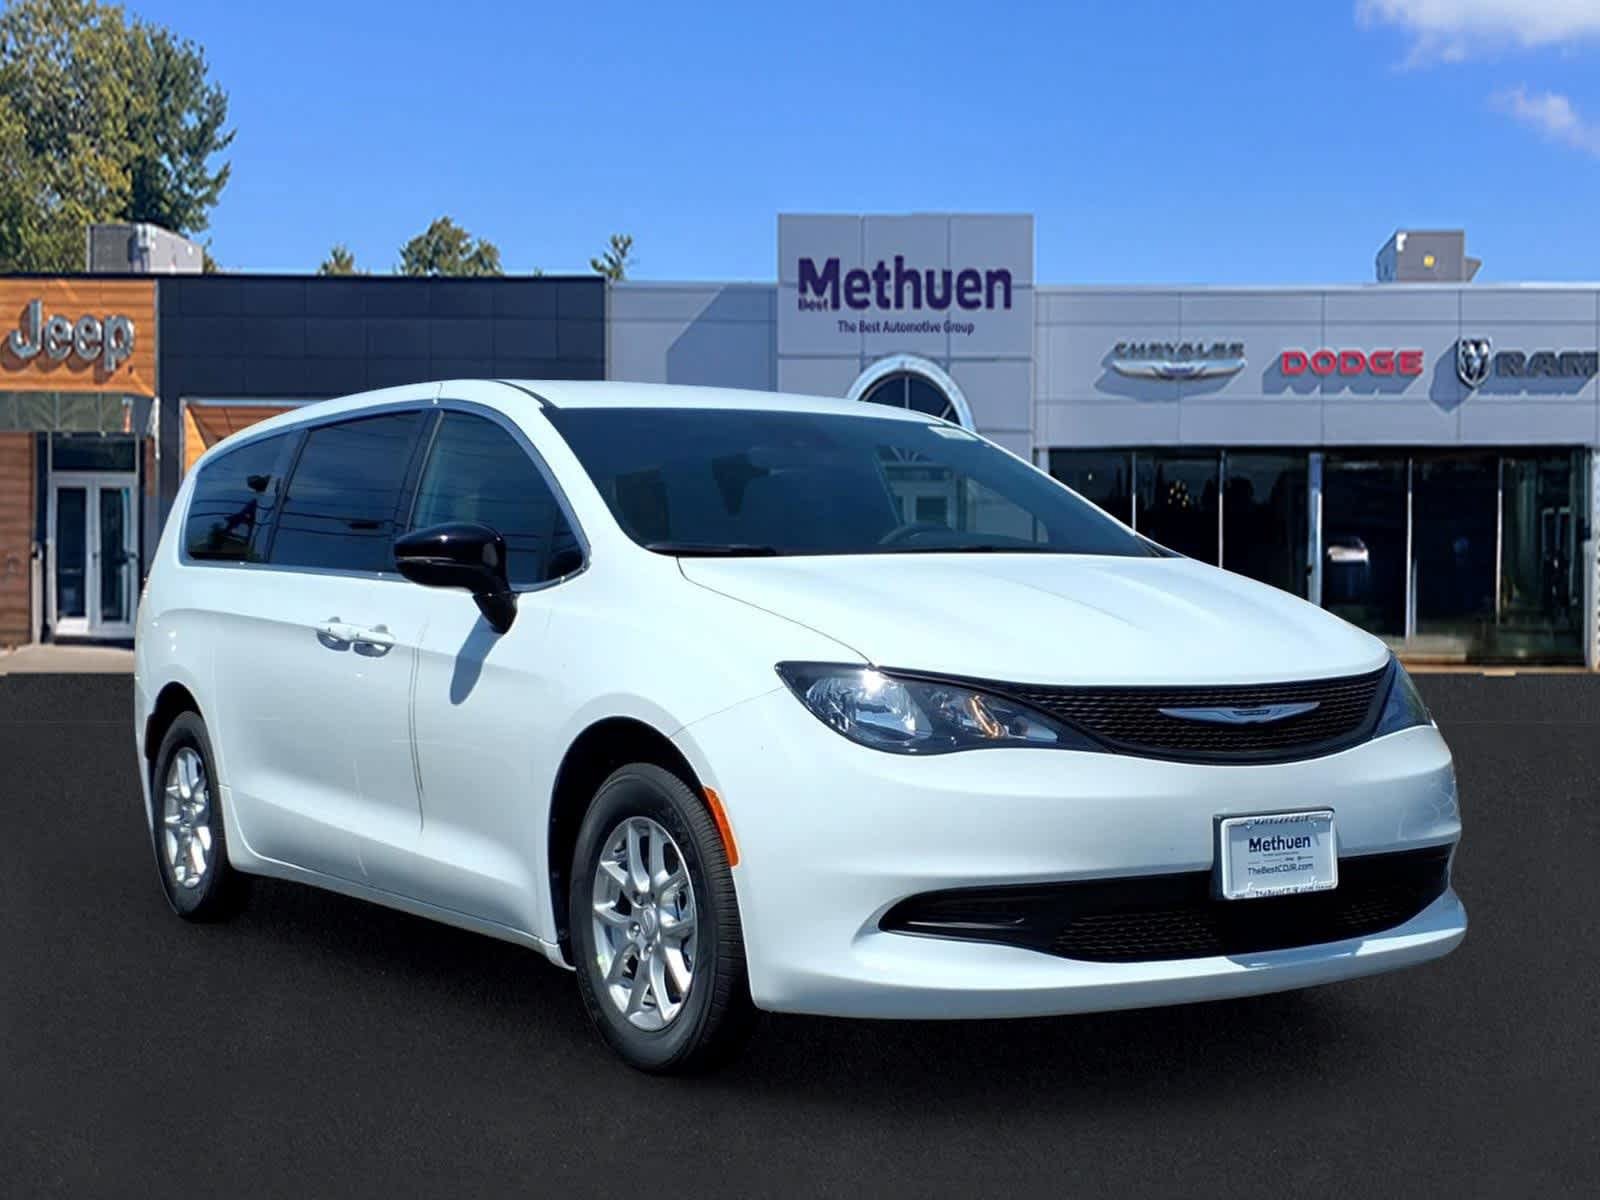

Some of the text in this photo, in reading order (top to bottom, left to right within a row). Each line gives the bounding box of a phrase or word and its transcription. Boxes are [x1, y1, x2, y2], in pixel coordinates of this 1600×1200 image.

[798, 255, 1012, 310] Methuen
[798, 298, 828, 311] Best
[9, 299, 135, 372] Jeep
[838, 320, 975, 335] The Best Automotive Group
[1113, 341, 1245, 359] CHRYSLER
[1281, 350, 1424, 375] DODGE
[1495, 351, 1599, 377] RAM
[1248, 835, 1311, 853] Methuen
